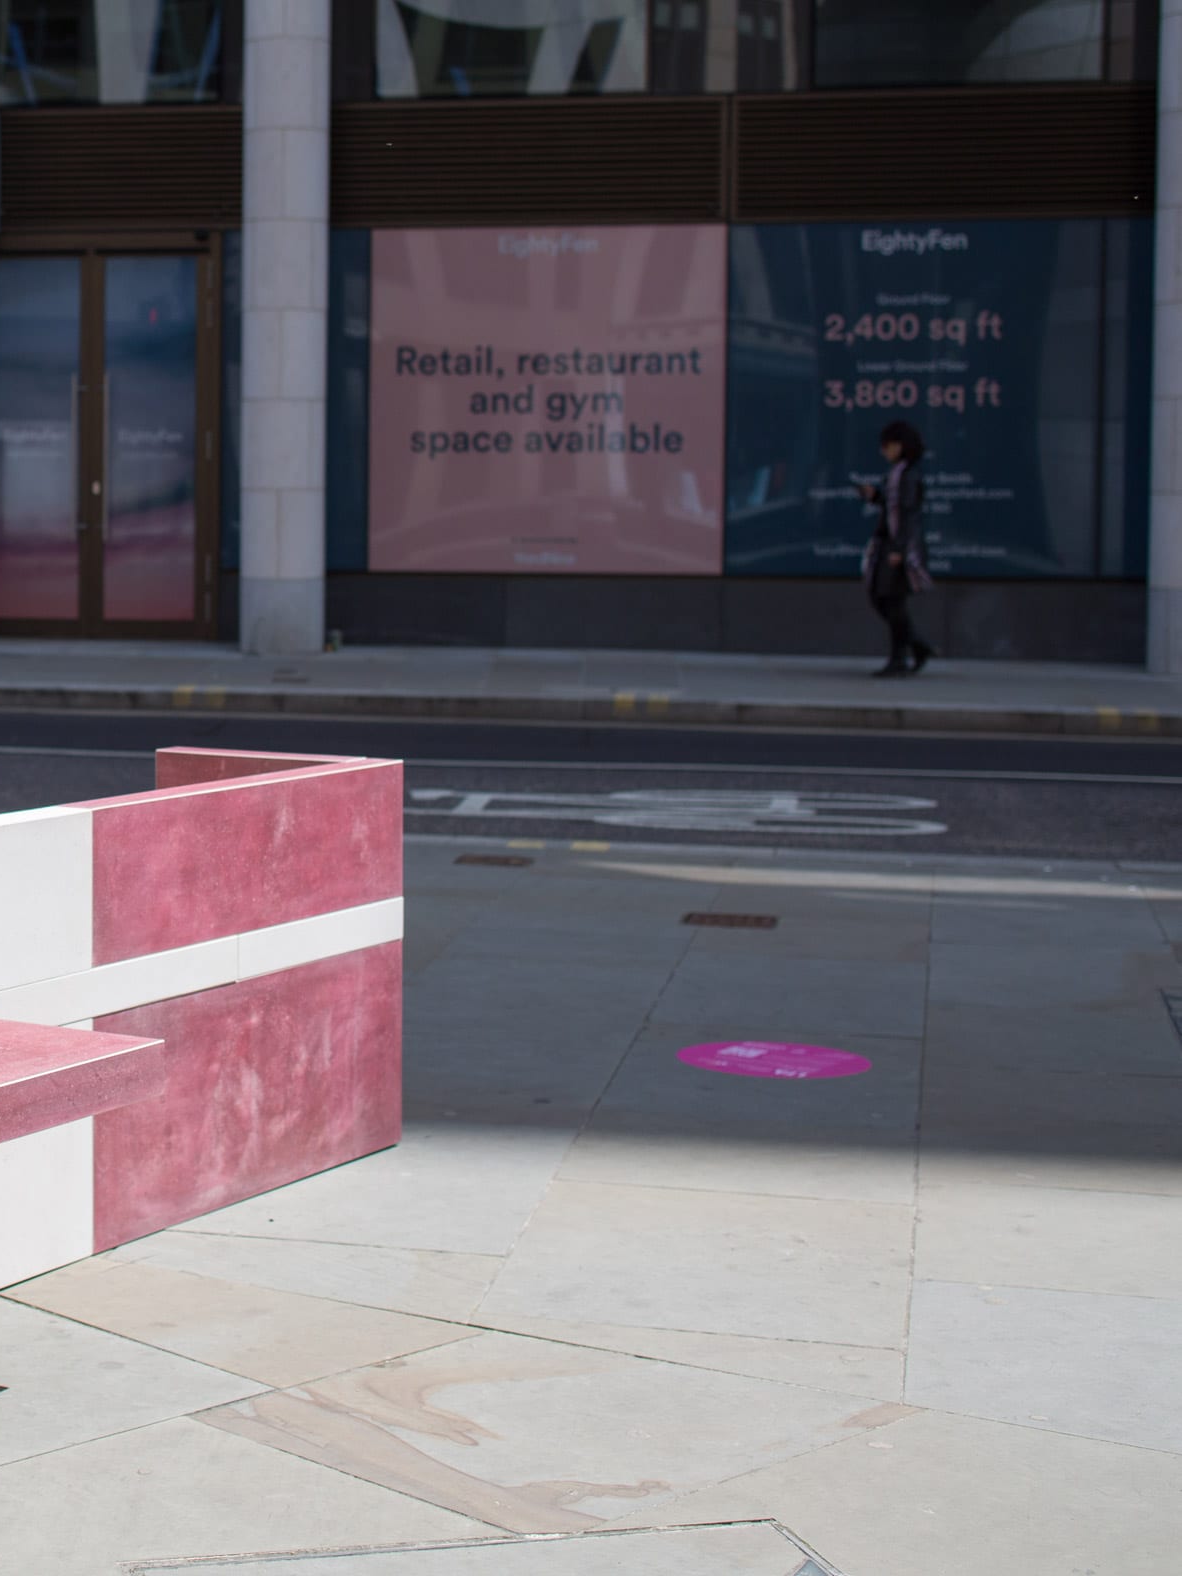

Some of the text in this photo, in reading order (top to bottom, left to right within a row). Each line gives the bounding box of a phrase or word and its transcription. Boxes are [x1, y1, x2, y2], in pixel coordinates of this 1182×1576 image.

[497, 232, 600, 259] EightyFen
[861, 229, 969, 256] EightyFen
[824, 309, 1003, 346] 2,400 sq ft
[395, 345, 702, 379] Retail, restaurant
[469, 384, 623, 421] and gym
[823, 377, 1002, 413] 3,860 sq ft
[409, 422, 685, 459] space available
